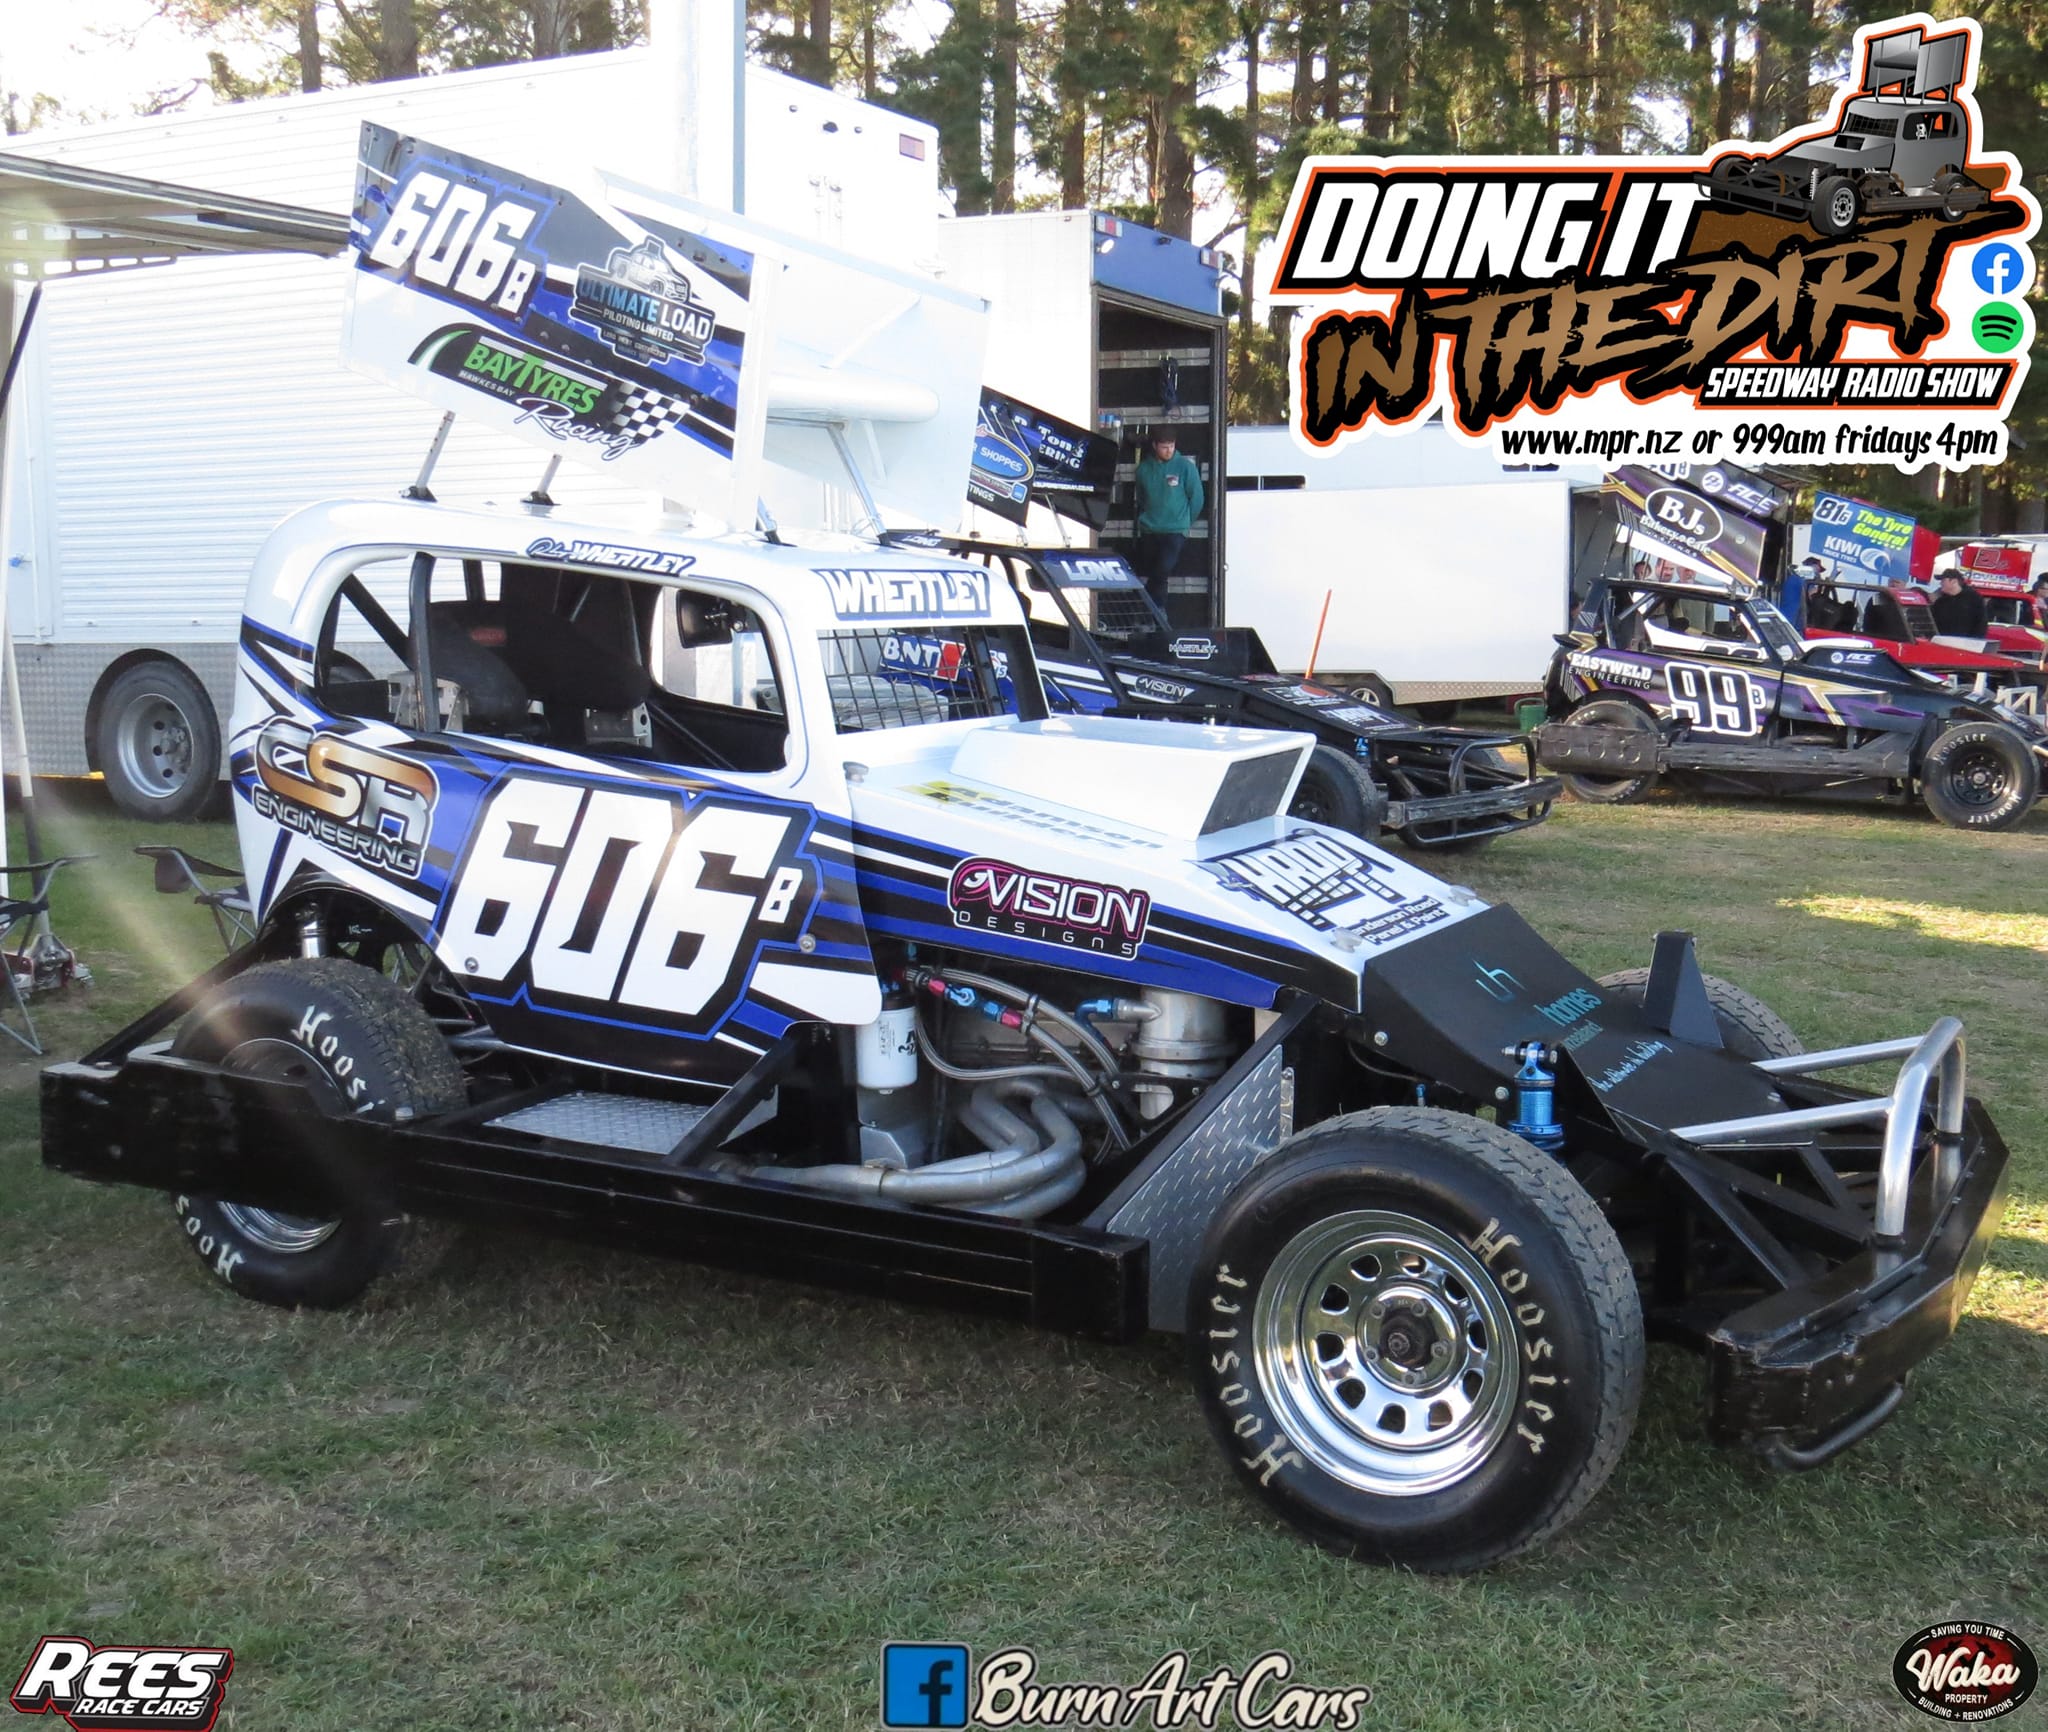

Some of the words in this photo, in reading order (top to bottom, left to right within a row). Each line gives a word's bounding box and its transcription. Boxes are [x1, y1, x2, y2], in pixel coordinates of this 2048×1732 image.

[577, 276, 661, 322] ULTIMATE
[660, 304, 711, 340] LOAD
[602, 307, 641, 330] PILOTING
[641, 322, 674, 342] LIMITED
[458, 370, 497, 392] HAWKES
[496, 384, 516, 397] BAY
[463, 343, 602, 414] BAYTYRES
[513, 396, 636, 461] Racing
[1639, 514, 1679, 540] Bakery
[1657, 496, 1705, 535] BJs
[1857, 509, 1883, 526] The
[570, 541, 694, 576] WHEATLEY
[1823, 535, 1862, 557] KIWI
[1060, 560, 1128, 581] LONG
[818, 570, 990, 617] WHEATLEY
[884, 636, 941, 669] BNT
[1570, 653, 1652, 681] EASTWELD
[1140, 677, 1184, 697] VISION
[1568, 667, 1650, 690] ENGINEERING
[254, 791, 419, 874] ENGINEERING
[435, 778, 803, 1016] 606B
[983, 868, 1142, 933] VISION
[958, 911, 1134, 955] DESIGNS
[1351, 907, 1410, 936] enderson
[1533, 988, 1602, 1027] homes
[1469, 1217, 1570, 1455] Hoosier
[1210, 1263, 1303, 1487] Hoosier
